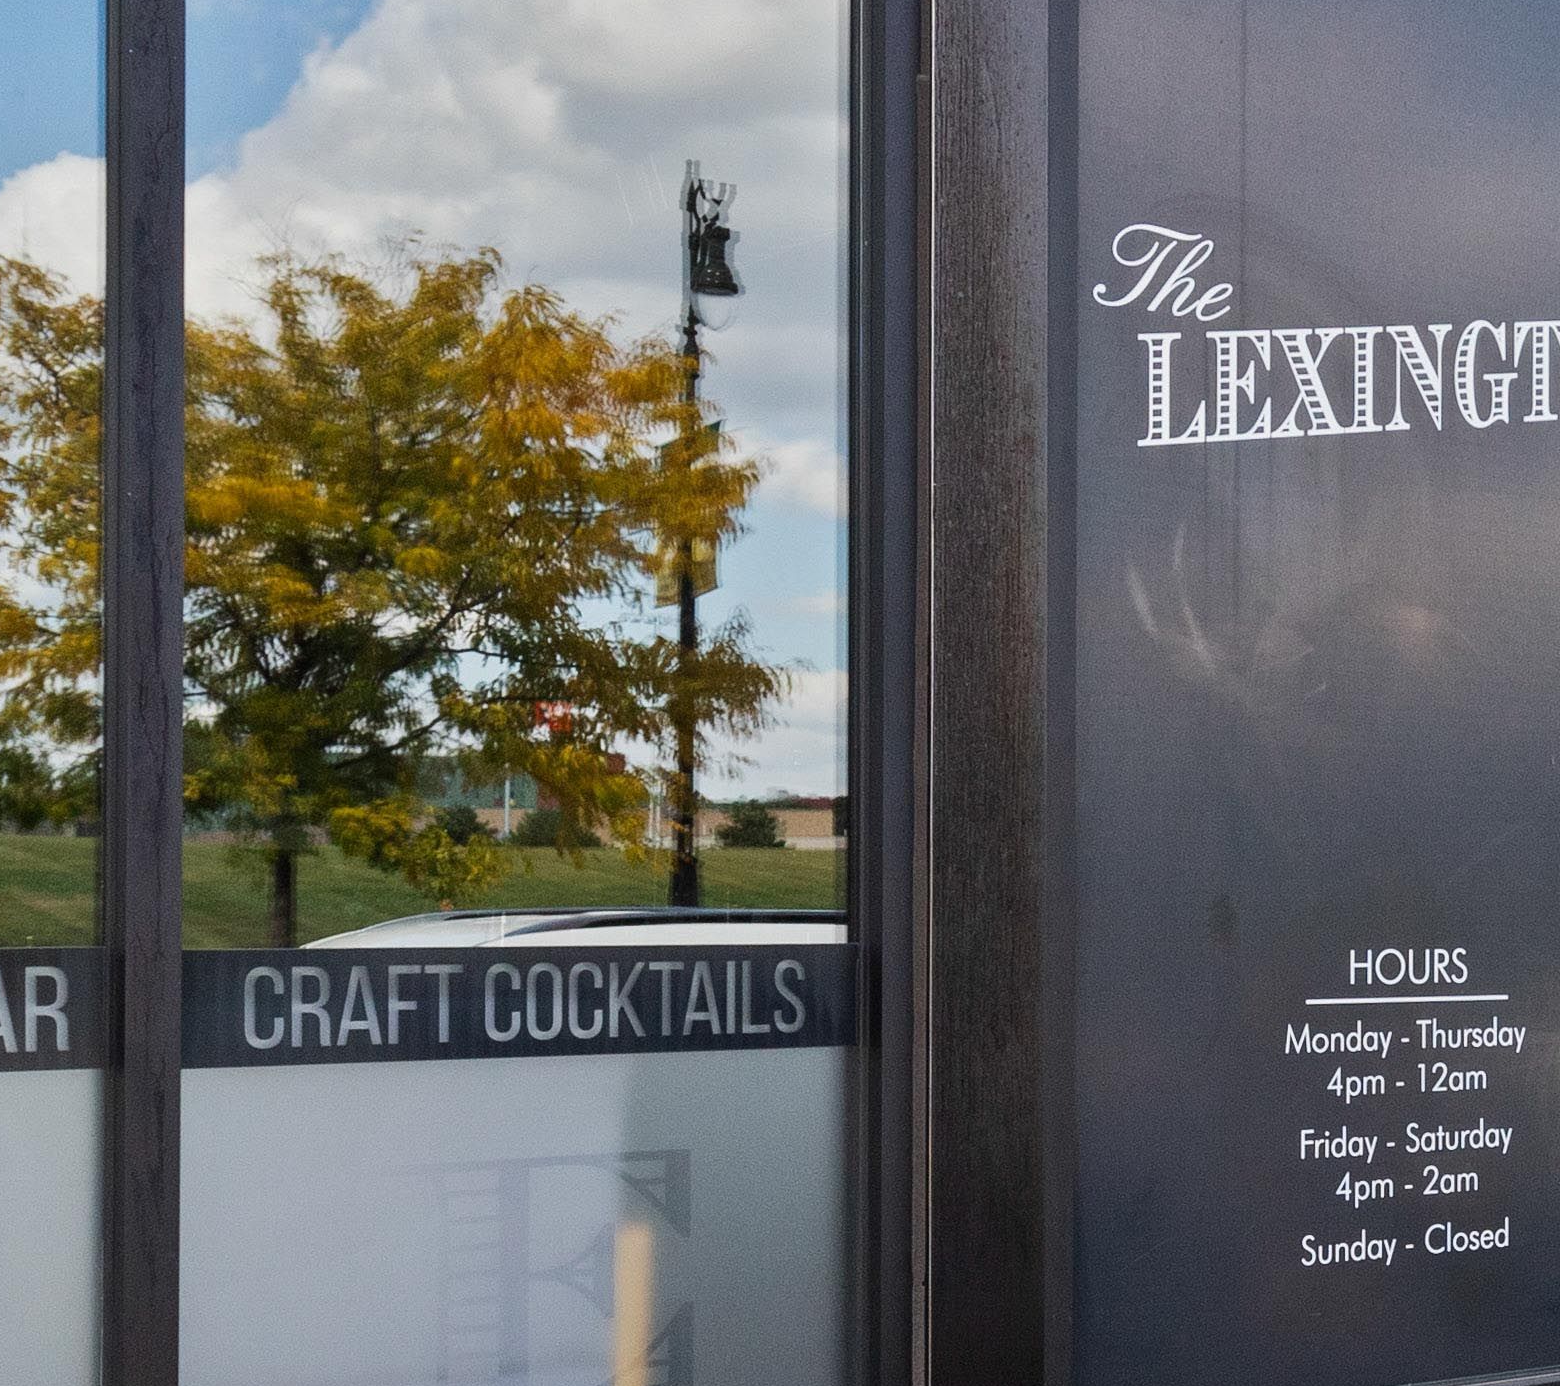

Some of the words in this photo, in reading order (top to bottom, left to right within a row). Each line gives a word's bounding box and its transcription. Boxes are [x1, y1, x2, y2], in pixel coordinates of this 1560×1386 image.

[1092, 222, 1234, 322] The
[1349, 947, 1469, 986] HOURS
[243, 963, 464, 1049] CRAFT
[484, 958, 807, 1041] COCKTAILS
[1284, 1020, 1393, 1059] Monday
[1415, 1016, 1527, 1054] Thursday
[1327, 1067, 1386, 1104] 4pm
[1417, 1061, 1487, 1092] 12am
[1300, 1125, 1378, 1164] Friday
[1405, 1117, 1513, 1155] Saturday
[1335, 1172, 1394, 1209] 4pm
[1423, 1164, 1479, 1195] 2am
[1301, 1229, 1397, 1267] Sunday
[1424, 1216, 1510, 1254] Closed
